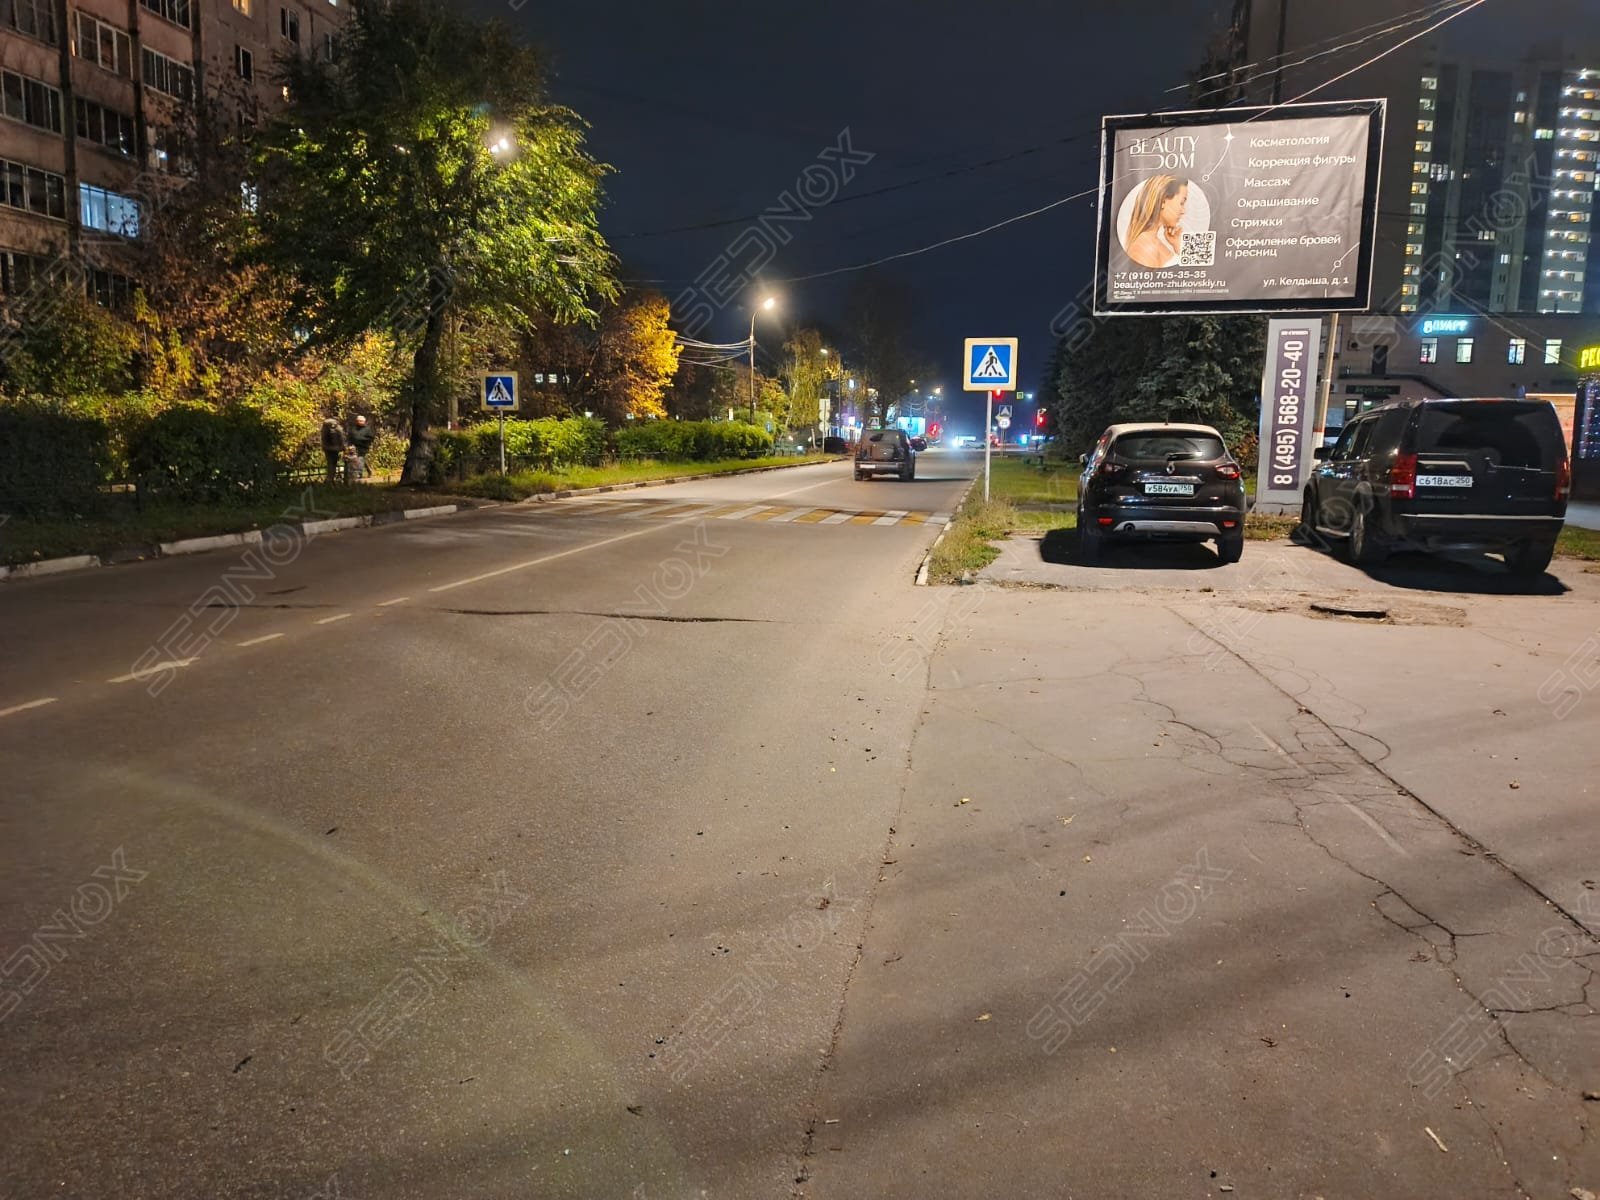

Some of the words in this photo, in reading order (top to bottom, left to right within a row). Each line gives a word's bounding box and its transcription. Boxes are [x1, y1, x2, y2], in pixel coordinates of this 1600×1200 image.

[1128, 135, 1199, 154] BEAUTY
[1249, 136, 1330, 148] Косметология
[1248, 156, 1310, 168] Коррекция
[1312, 155, 1356, 167] фигуры
[1244, 177, 1291, 188] Массаж
[1237, 197, 1320, 209] Окрашивание
[1231, 218, 1283, 229] Стрижки
[1225, 236, 1298, 249] Оформление
[1299, 235, 1341, 247] бровей
[1225, 249, 1232, 257] и
[1234, 249, 1278, 260] ресниц
[1128, 271, 1154, 281] (916)
[1156, 270, 1207, 279] 705-35-35
[1113, 280, 1226, 290] beautydom-zhukovskiy.ru
[1263, 279, 1276, 288] ул.
[1279, 277, 1330, 286] Келдыша,
[1343, 276, 1349, 284] 1
[1278, 340, 1304, 425] 568-20-40
[1273, 431, 1299, 471] (495)
[1273, 474, 1293, 485] 8
